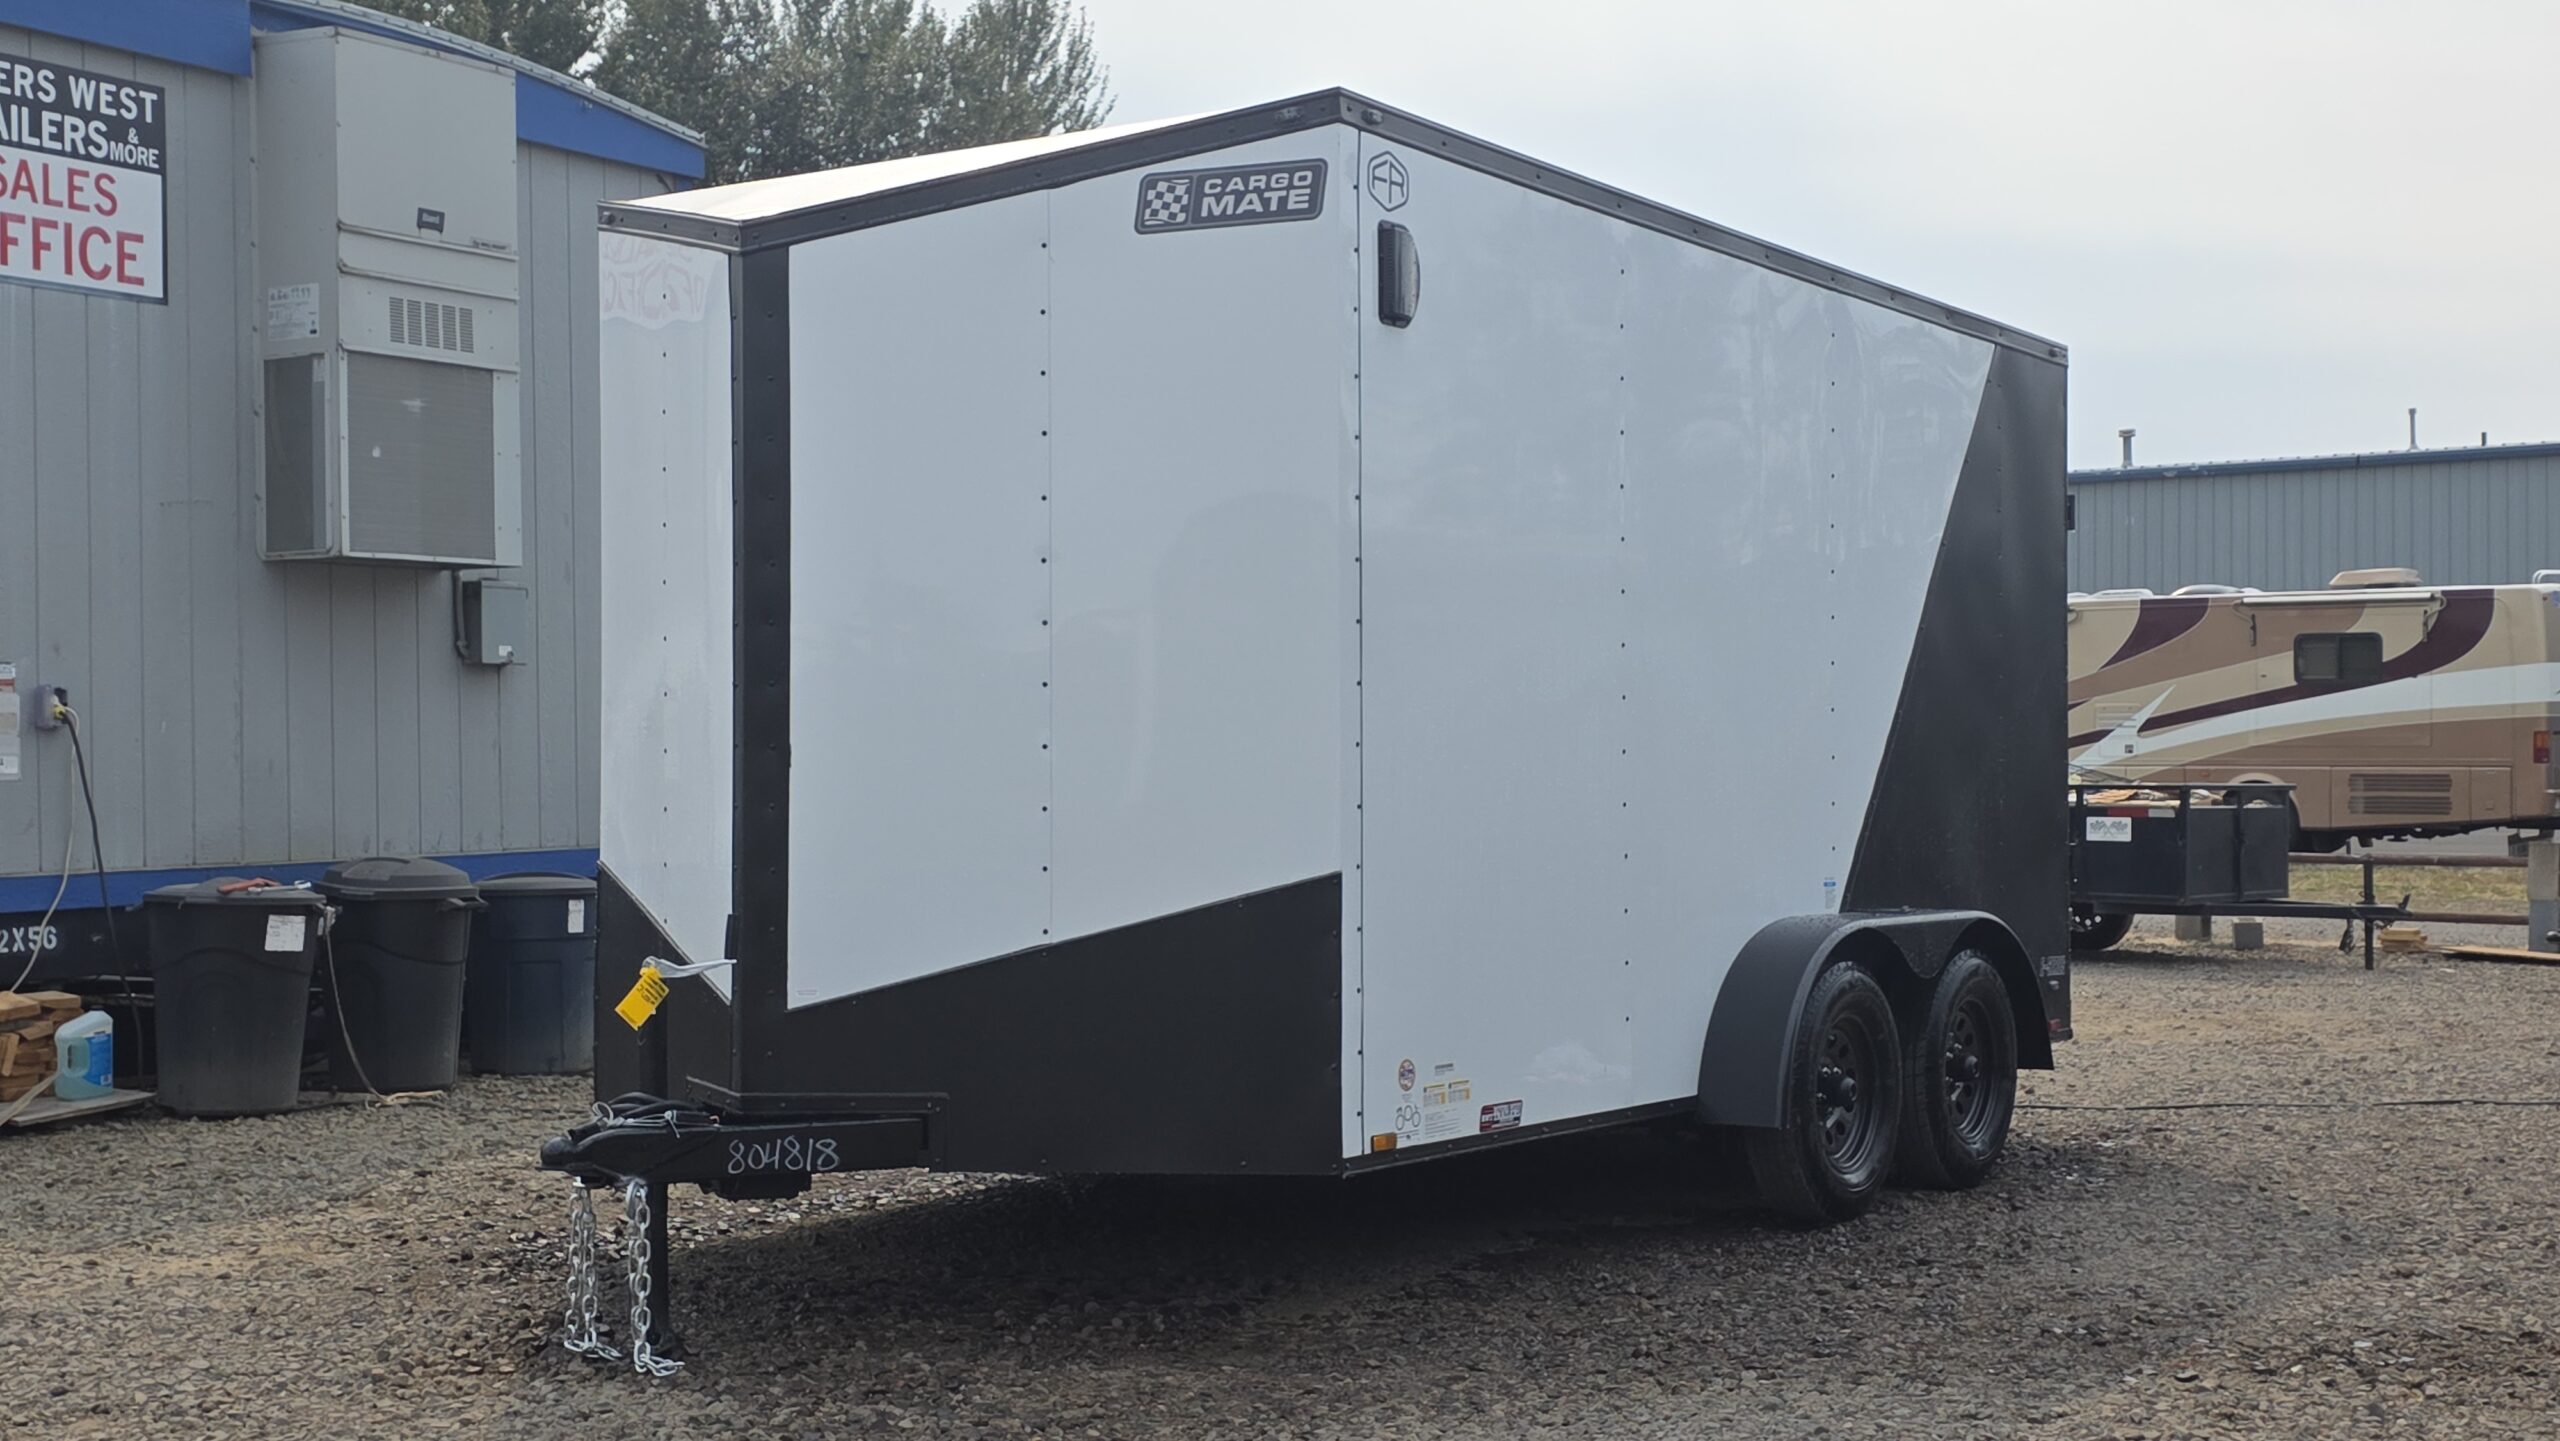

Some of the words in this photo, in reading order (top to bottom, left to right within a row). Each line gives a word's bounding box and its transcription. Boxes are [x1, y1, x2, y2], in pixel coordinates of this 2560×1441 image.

[68, 75, 158, 123] WEST
[128, 127, 139, 145] &
[110, 141, 159, 168] MORE
[1204, 170, 1313, 194] CARGO
[1201, 188, 1311, 217] MATE
[0, 211, 145, 287] FFICE
[728, 1135, 840, 1174] 804818
